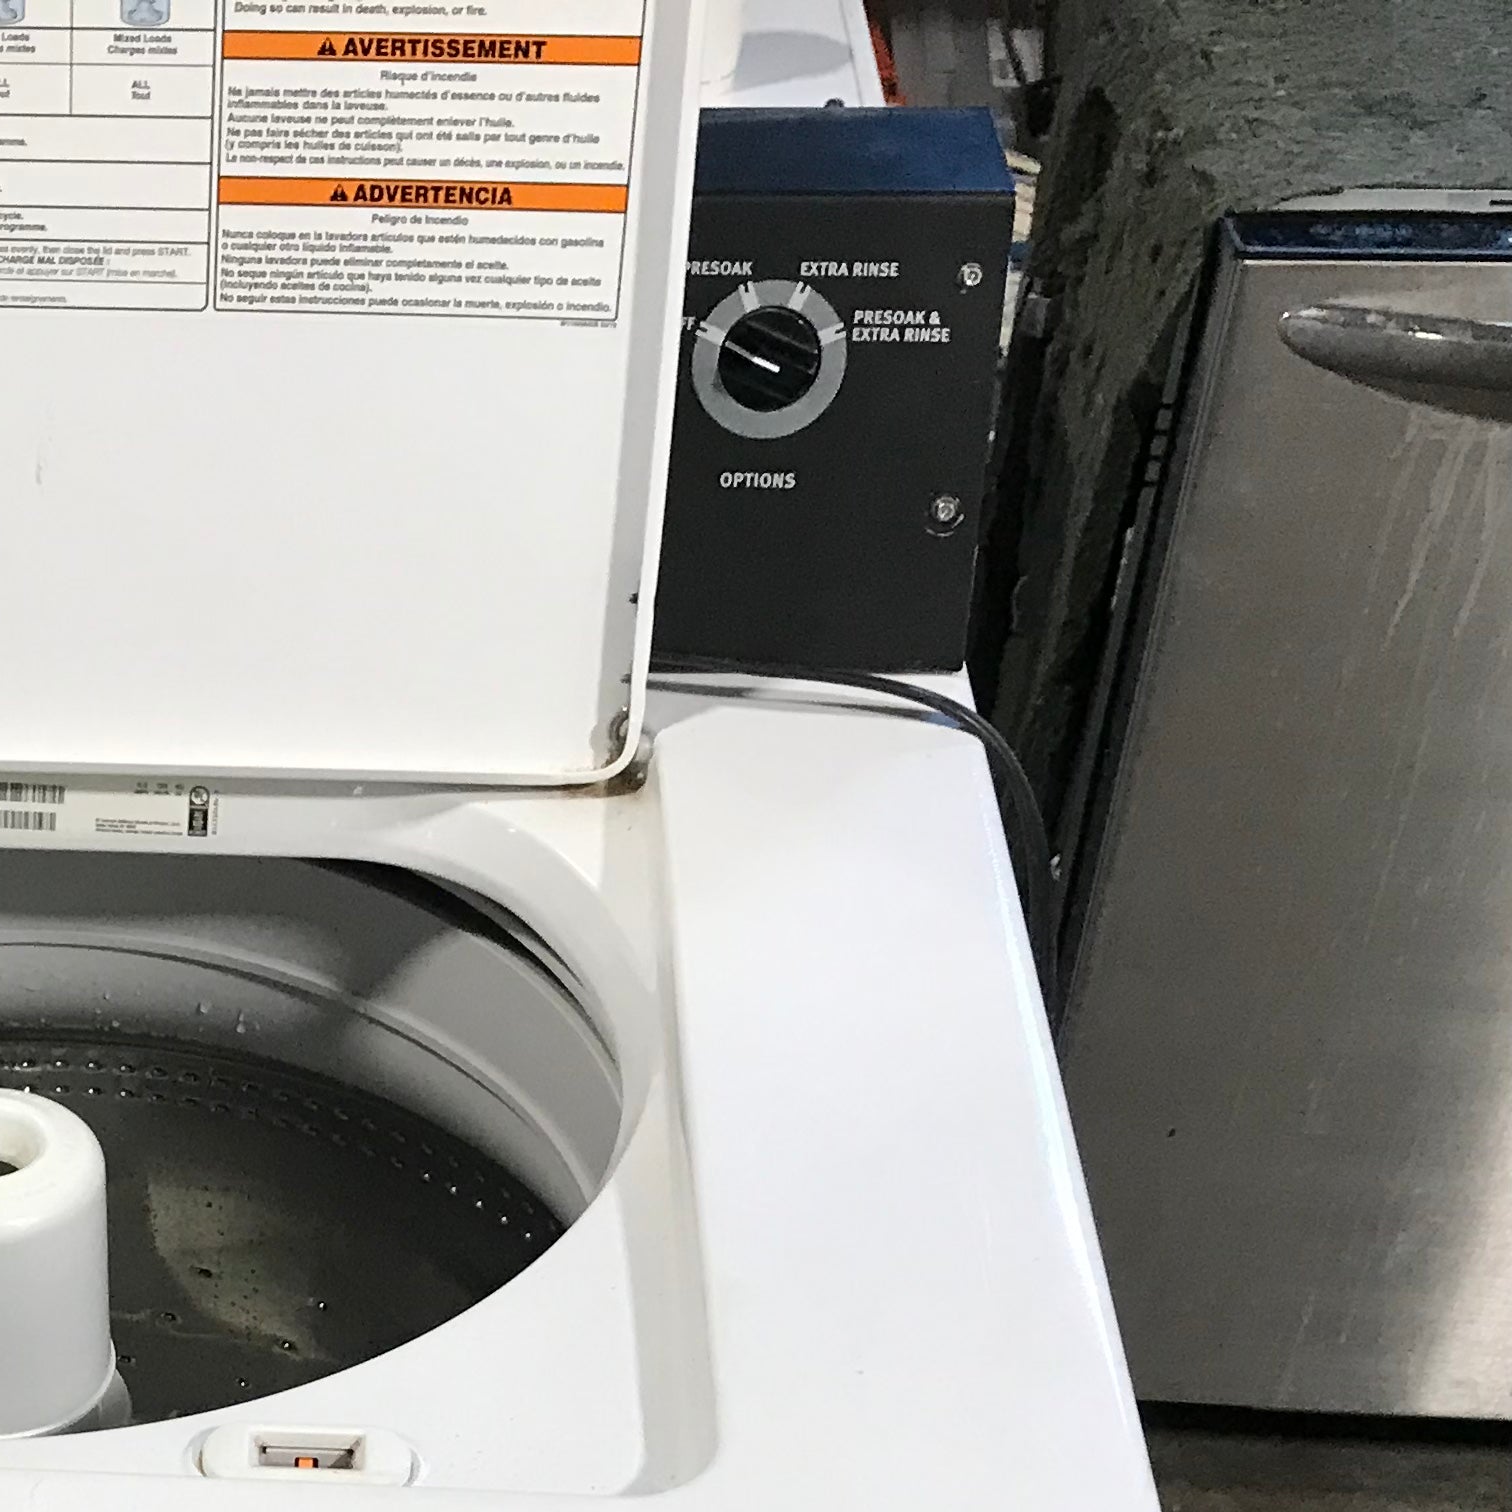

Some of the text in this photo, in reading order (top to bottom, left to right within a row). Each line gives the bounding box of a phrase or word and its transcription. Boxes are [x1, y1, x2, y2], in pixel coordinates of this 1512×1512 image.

[234, 3, 266, 14] Doing
[269, 4, 282, 13] so
[285, 5, 305, 13] can
[308, 3, 339, 13] result
[342, 4, 352, 13] in
[341, 37, 547, 60] AVERTISSEMENT
[353, 184, 513, 205] ADVERTENCIA
[410, 214, 422, 224] de
[800, 261, 900, 277] EXTRA RINSE
[853, 310, 941, 325] PRESOAK &
[852, 327, 951, 343] EXTRA RINSE
[719, 472, 796, 489] OPTIONS
